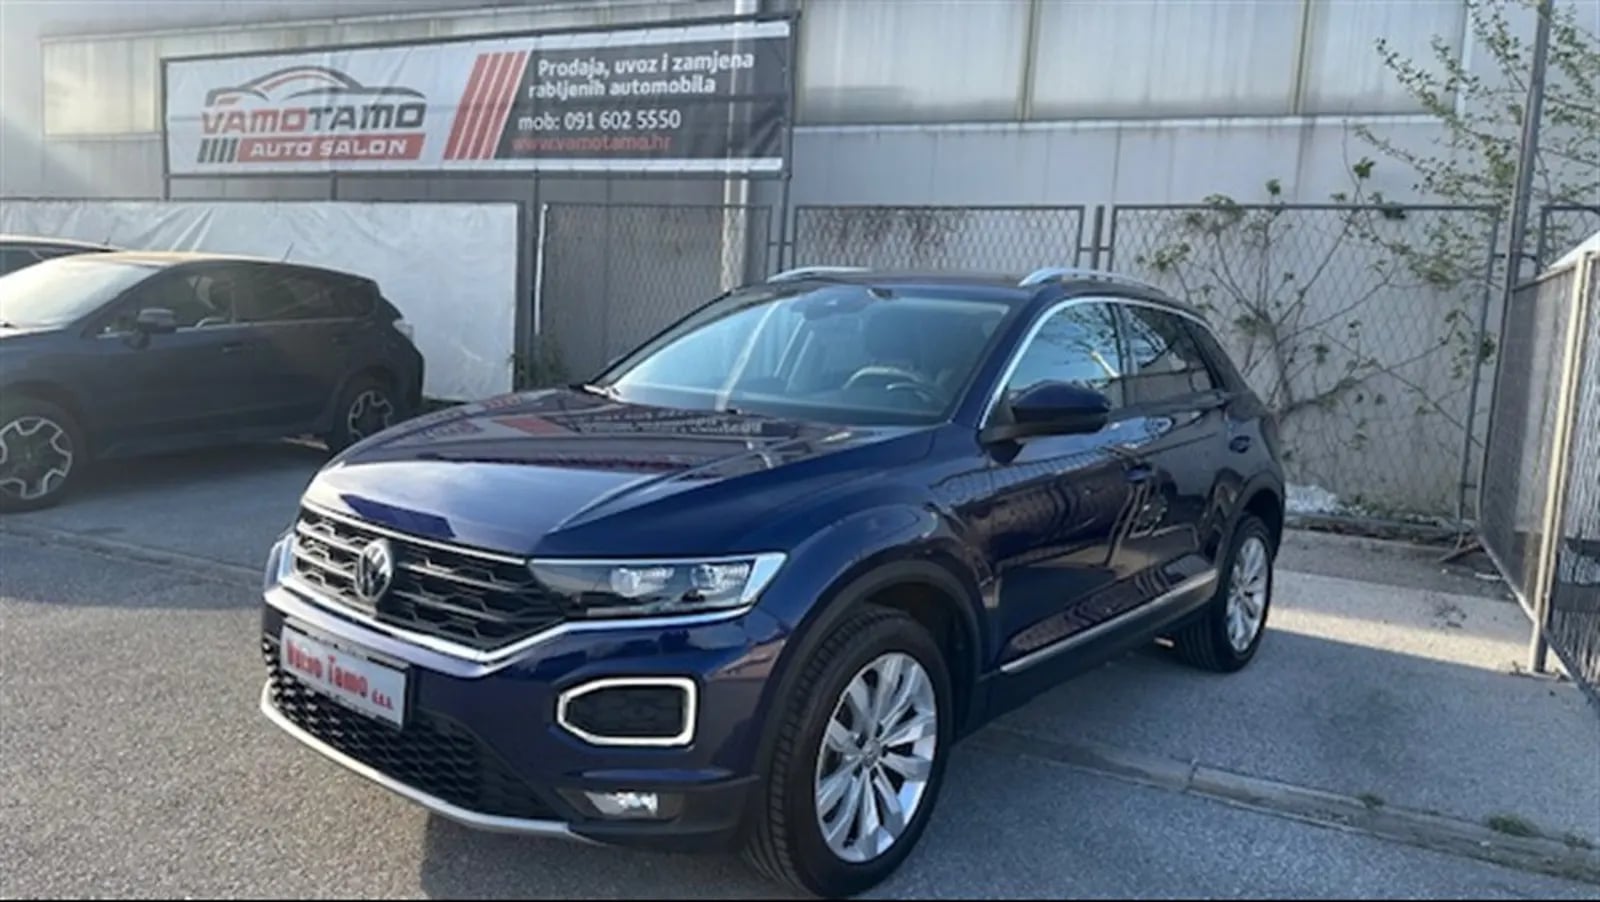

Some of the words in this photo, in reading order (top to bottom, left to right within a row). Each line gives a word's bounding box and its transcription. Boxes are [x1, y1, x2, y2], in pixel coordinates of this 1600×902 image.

[538, 56, 611, 79] Prodaja,
[614, 58, 658, 75] uvoz
[661, 53, 668, 72] i
[671, 50, 754, 74] zamjena
[528, 79, 605, 101] rabljenih
[609, 75, 716, 96] automobila
[202, 103, 427, 135] VAMOTAMO
[518, 112, 561, 131] mob:
[564, 111, 595, 130] 091
[599, 111, 632, 130] 602
[636, 109, 682, 129] 5550
[250, 139, 312, 158] AUTO
[319, 138, 408, 156] SALON
